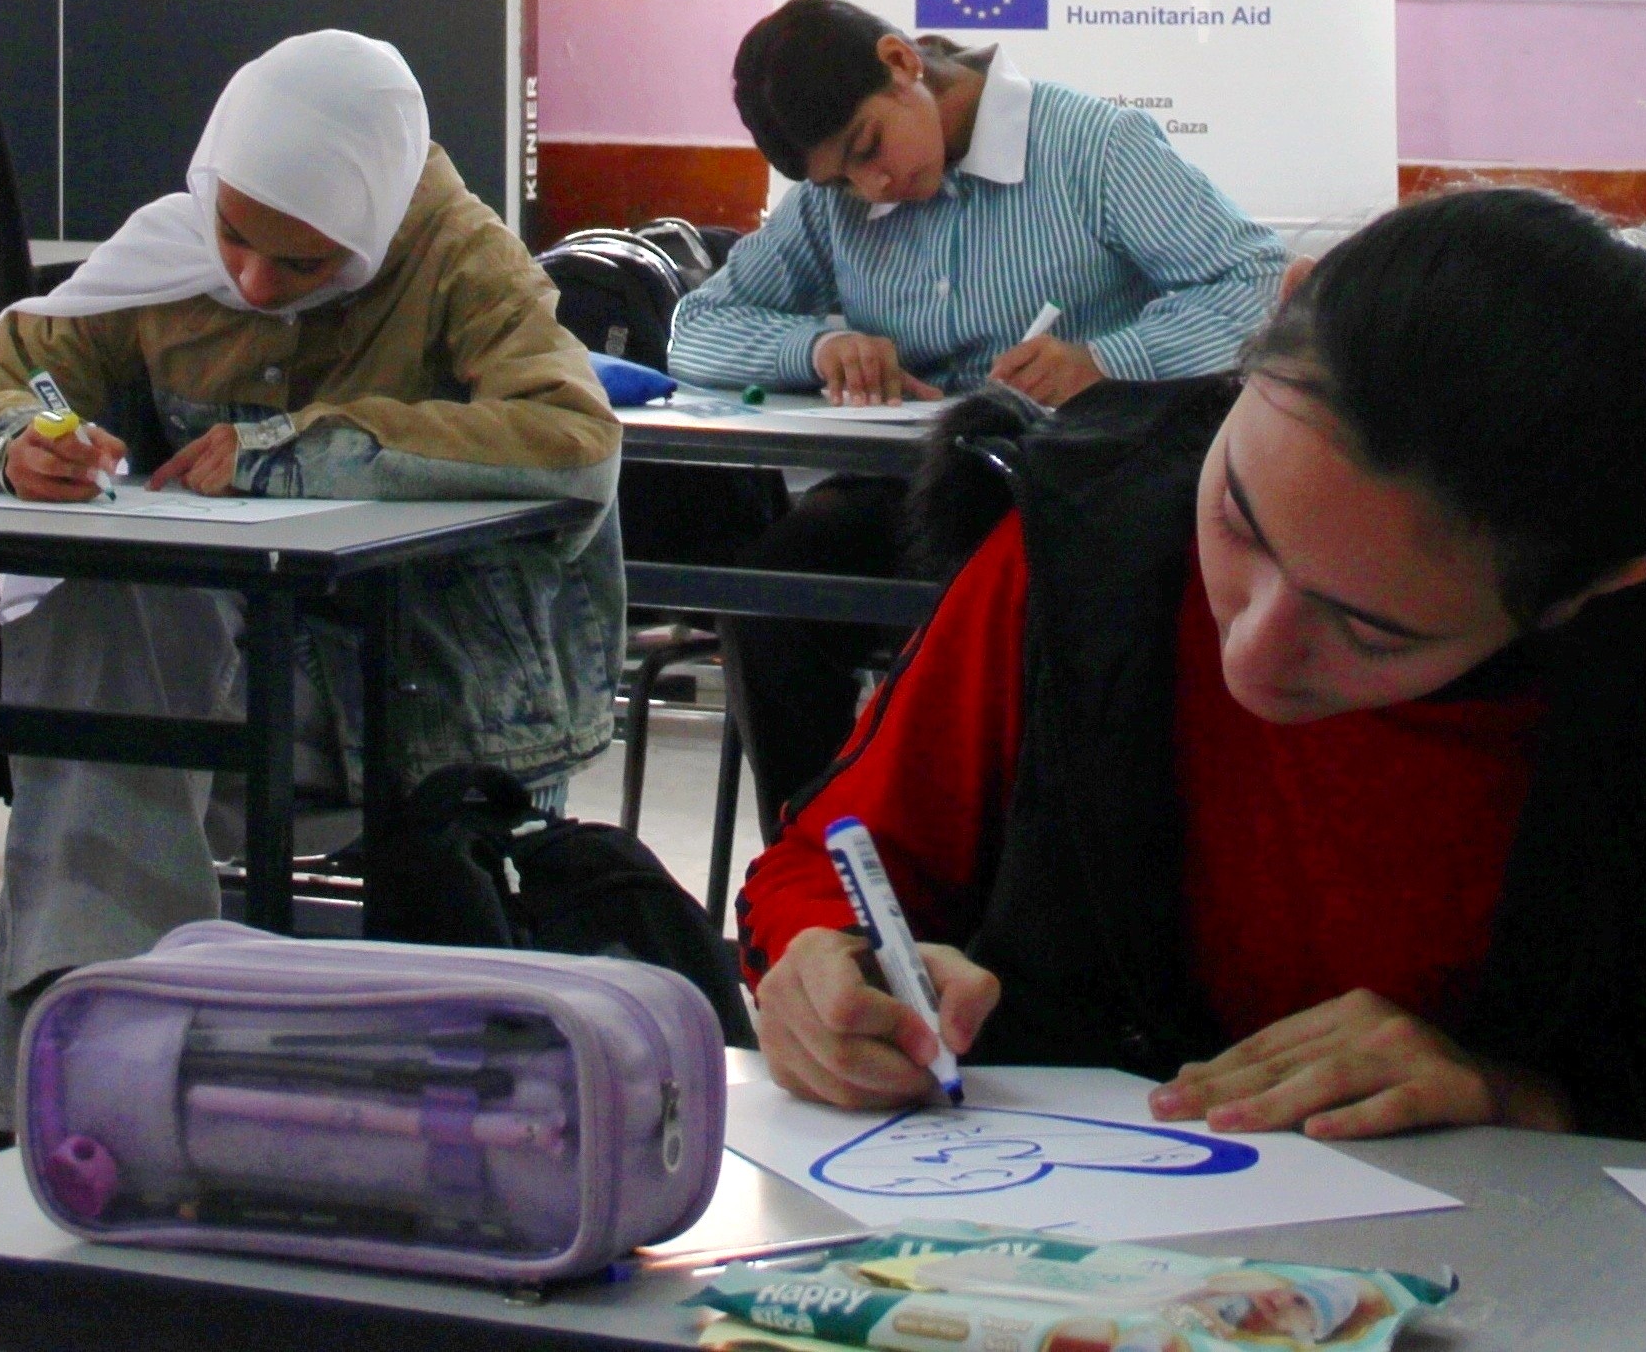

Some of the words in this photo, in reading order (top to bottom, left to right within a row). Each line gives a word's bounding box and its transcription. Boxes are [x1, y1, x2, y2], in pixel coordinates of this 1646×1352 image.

[1066, 7, 1224, 27] Humanitarian
[1232, 7, 1271, 26] Aid
[525, 76, 538, 200] KENIER
[1166, 119, 1208, 134] Gaza
[756, 1282, 874, 1315] Happy
